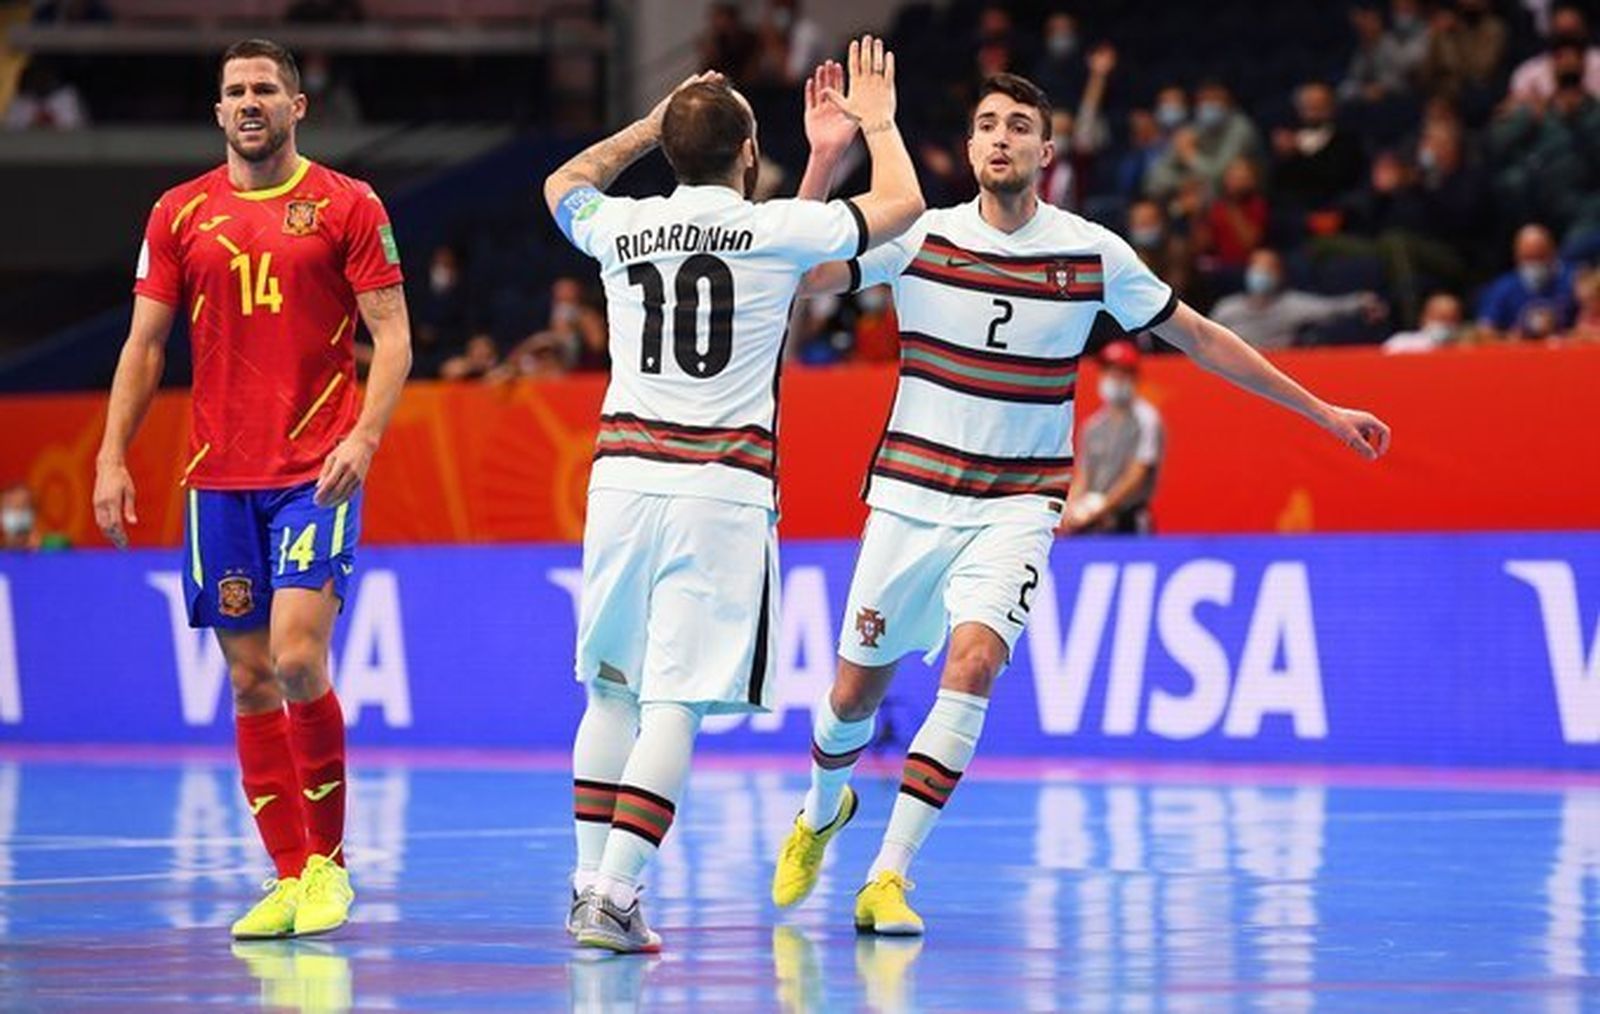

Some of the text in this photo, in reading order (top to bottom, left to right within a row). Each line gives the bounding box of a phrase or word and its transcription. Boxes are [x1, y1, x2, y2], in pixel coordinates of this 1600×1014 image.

[615, 223, 753, 263] RICARDINHO
[230, 251, 283, 316] 14
[628, 253, 734, 378] 10
[986, 299, 1013, 349] 2
[278, 522, 317, 575] 14
[1018, 563, 1039, 612] 2
[146, 569, 412, 728] VA
[1026, 558, 1329, 740] VISA
